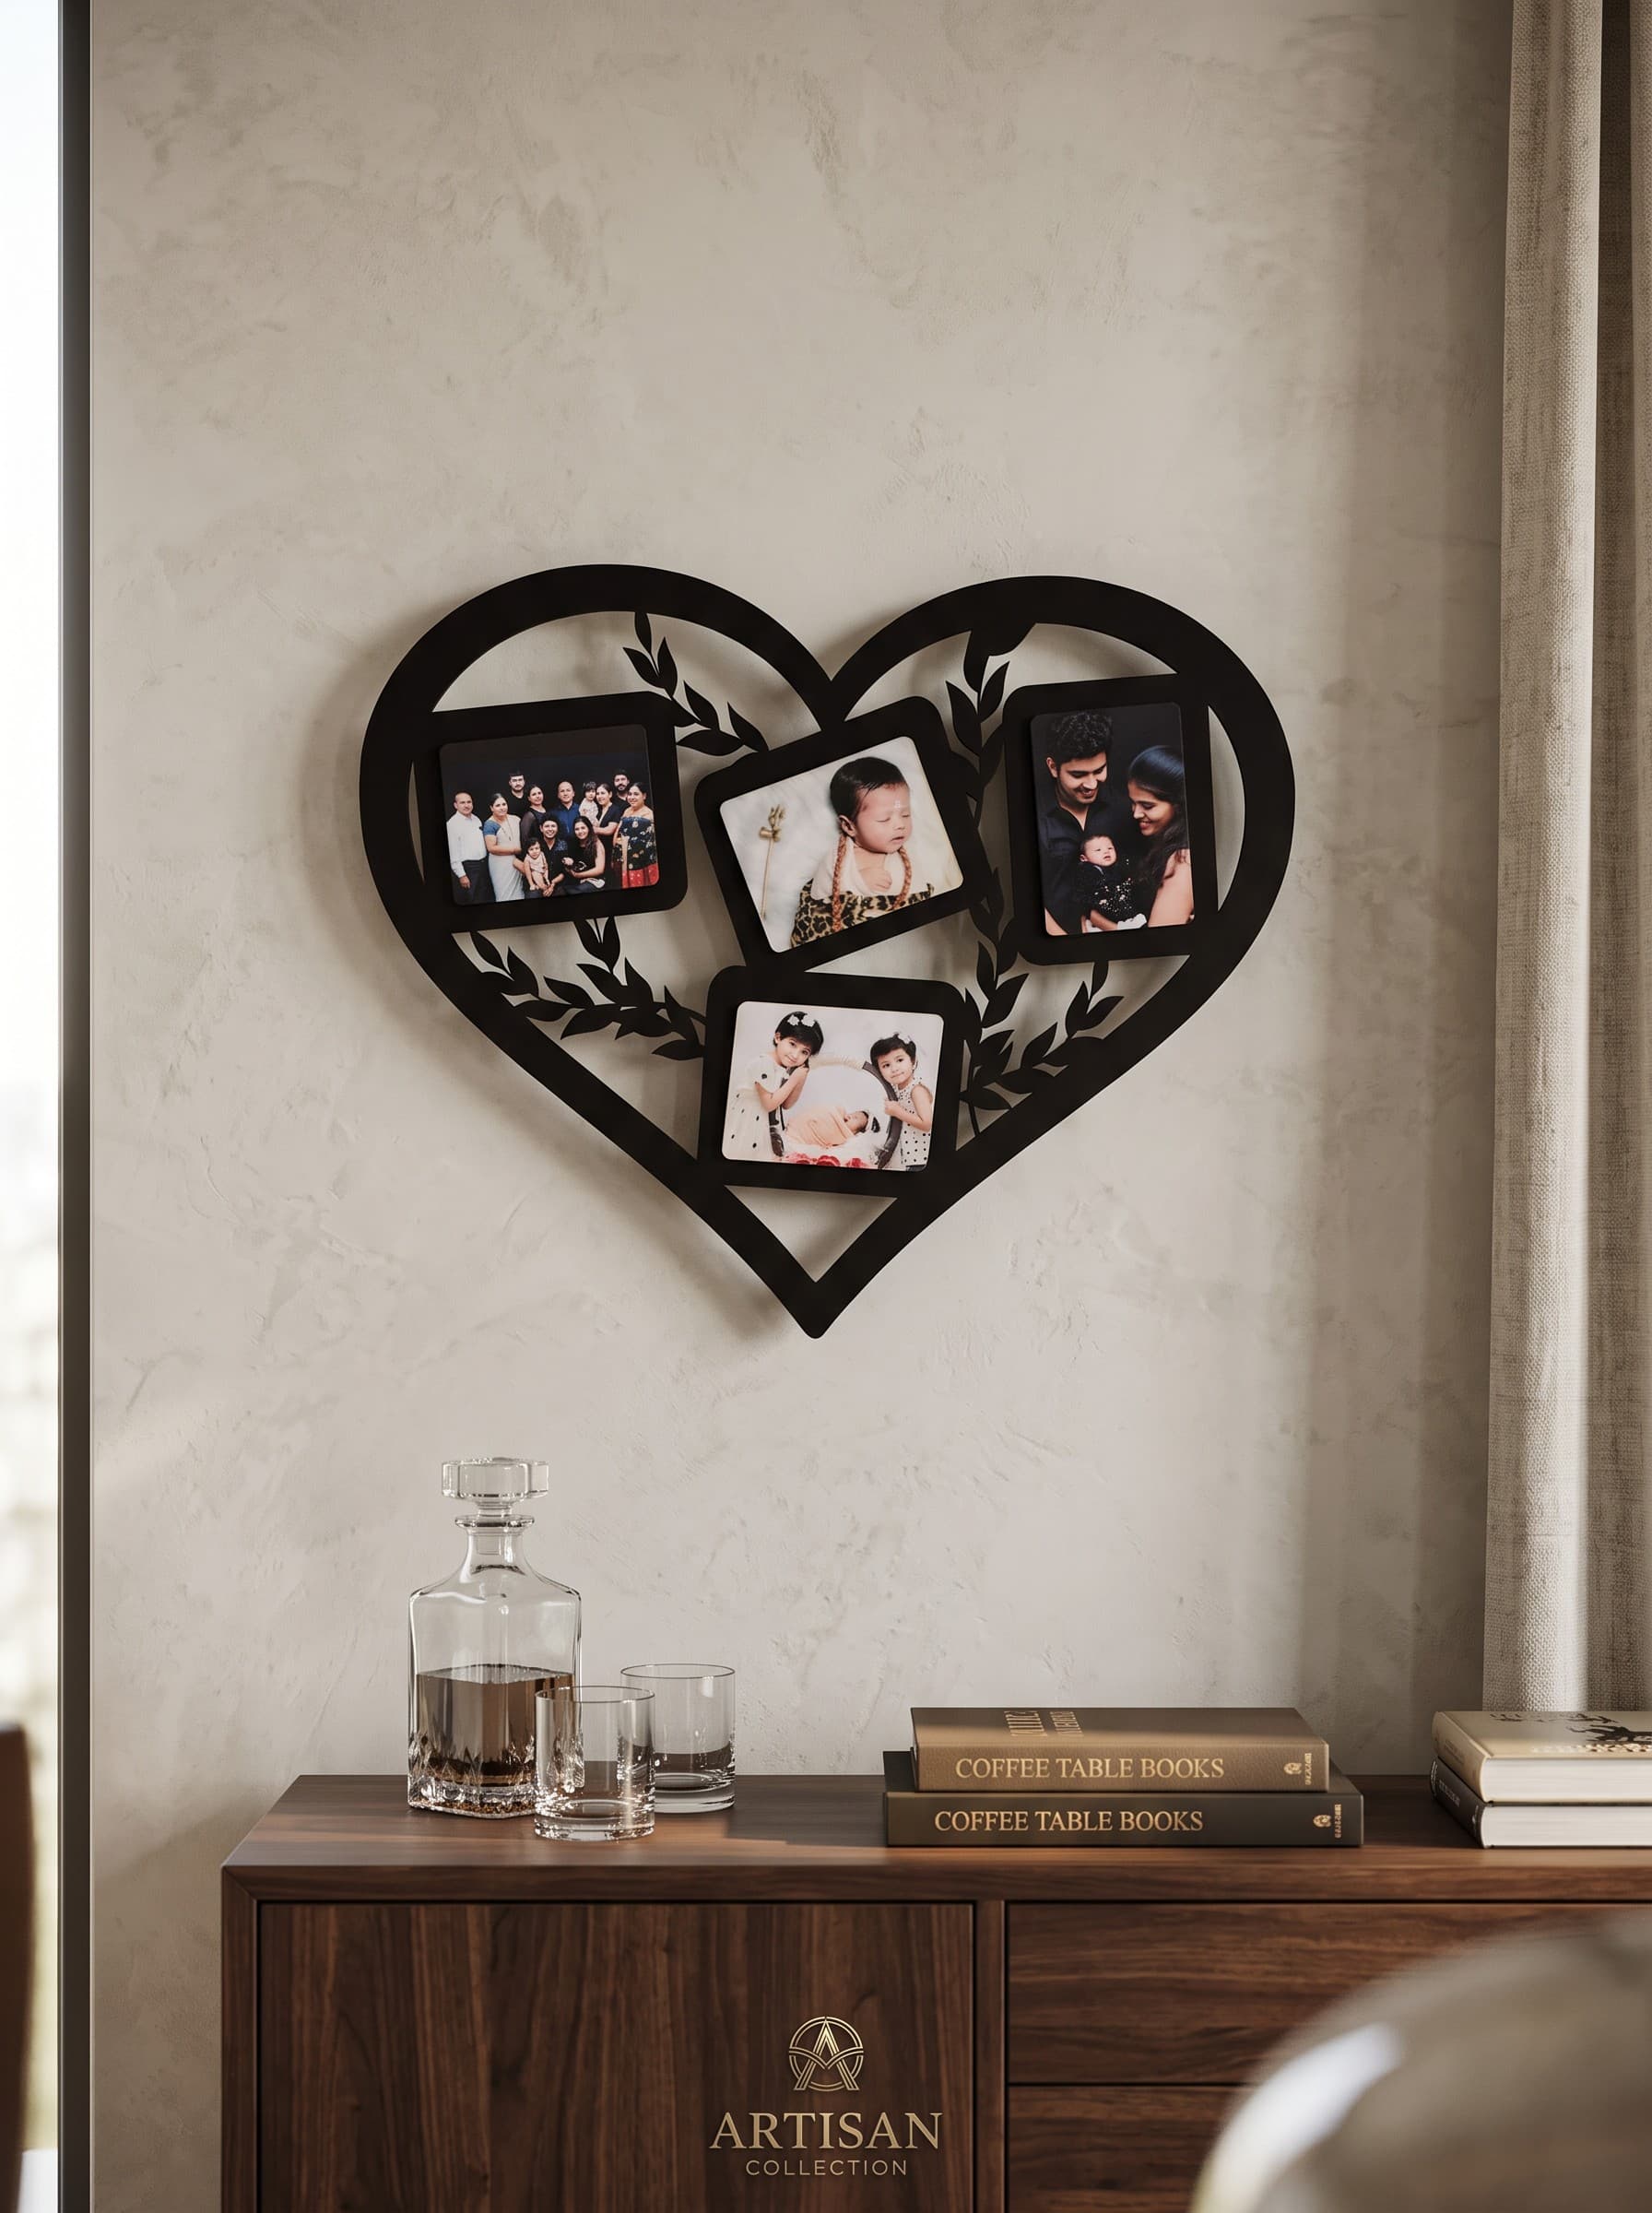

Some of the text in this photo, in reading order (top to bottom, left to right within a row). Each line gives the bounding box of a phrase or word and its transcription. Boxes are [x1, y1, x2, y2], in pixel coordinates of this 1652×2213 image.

[955, 1757, 1225, 1780] COFFEE TABLE BOOKS
[934, 1810, 1203, 1831] COFFEE TABLE BOOKS
